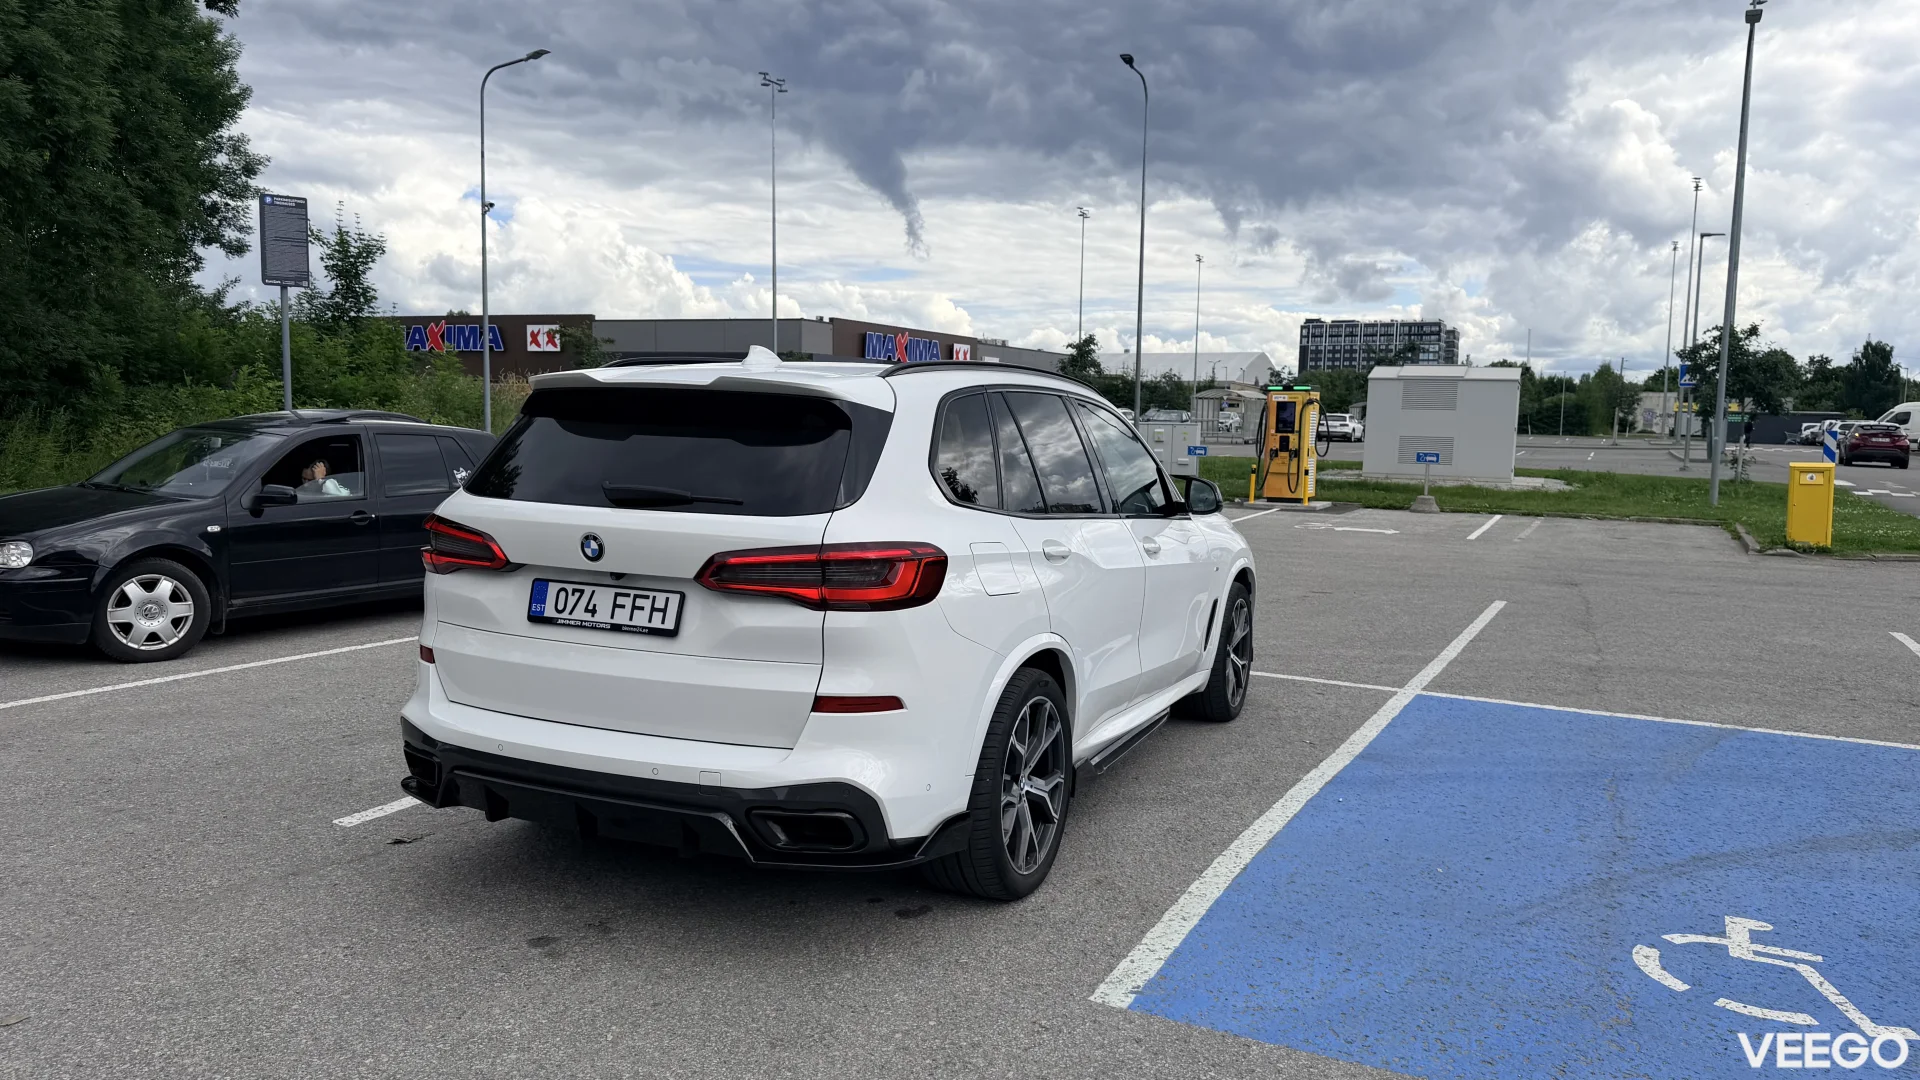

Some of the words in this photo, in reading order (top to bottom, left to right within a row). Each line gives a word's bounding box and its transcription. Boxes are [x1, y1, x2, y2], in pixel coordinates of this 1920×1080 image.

[400, 320, 504, 352] AXIMA
[865, 331, 941, 363] MAXIMA
[531, 603, 546, 612] EST
[554, 586, 597, 618] 074
[610, 591, 670, 625] FFH
[581, 621, 611, 629] MOTORS
